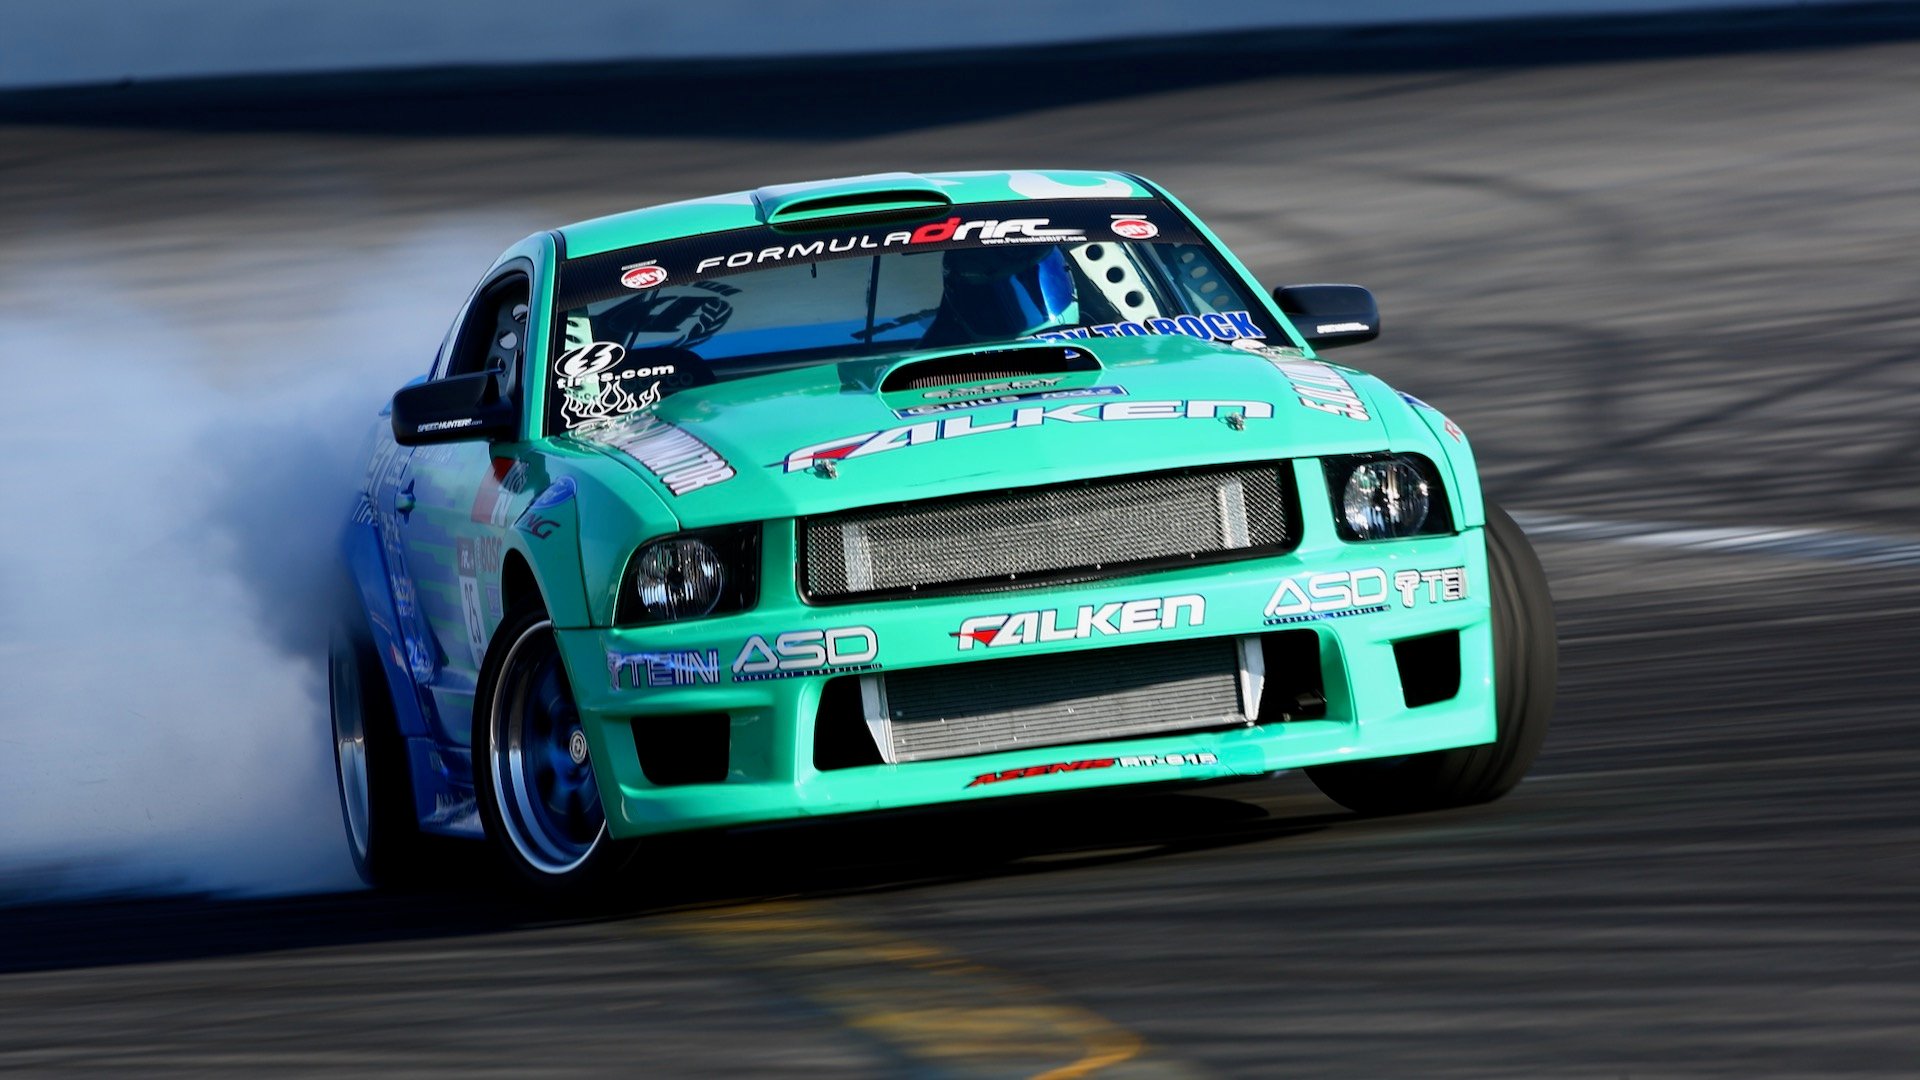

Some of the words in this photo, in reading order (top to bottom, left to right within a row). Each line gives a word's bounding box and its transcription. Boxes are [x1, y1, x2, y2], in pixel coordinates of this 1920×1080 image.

[696, 231, 911, 274] FORMULA
[1146, 310, 1267, 342] ROCK
[782, 400, 1275, 474] FALKEN
[1263, 567, 1388, 618] ASD
[954, 594, 1207, 652] FALKEN
[618, 650, 720, 687] TEIN
[731, 625, 879, 674] ASD
